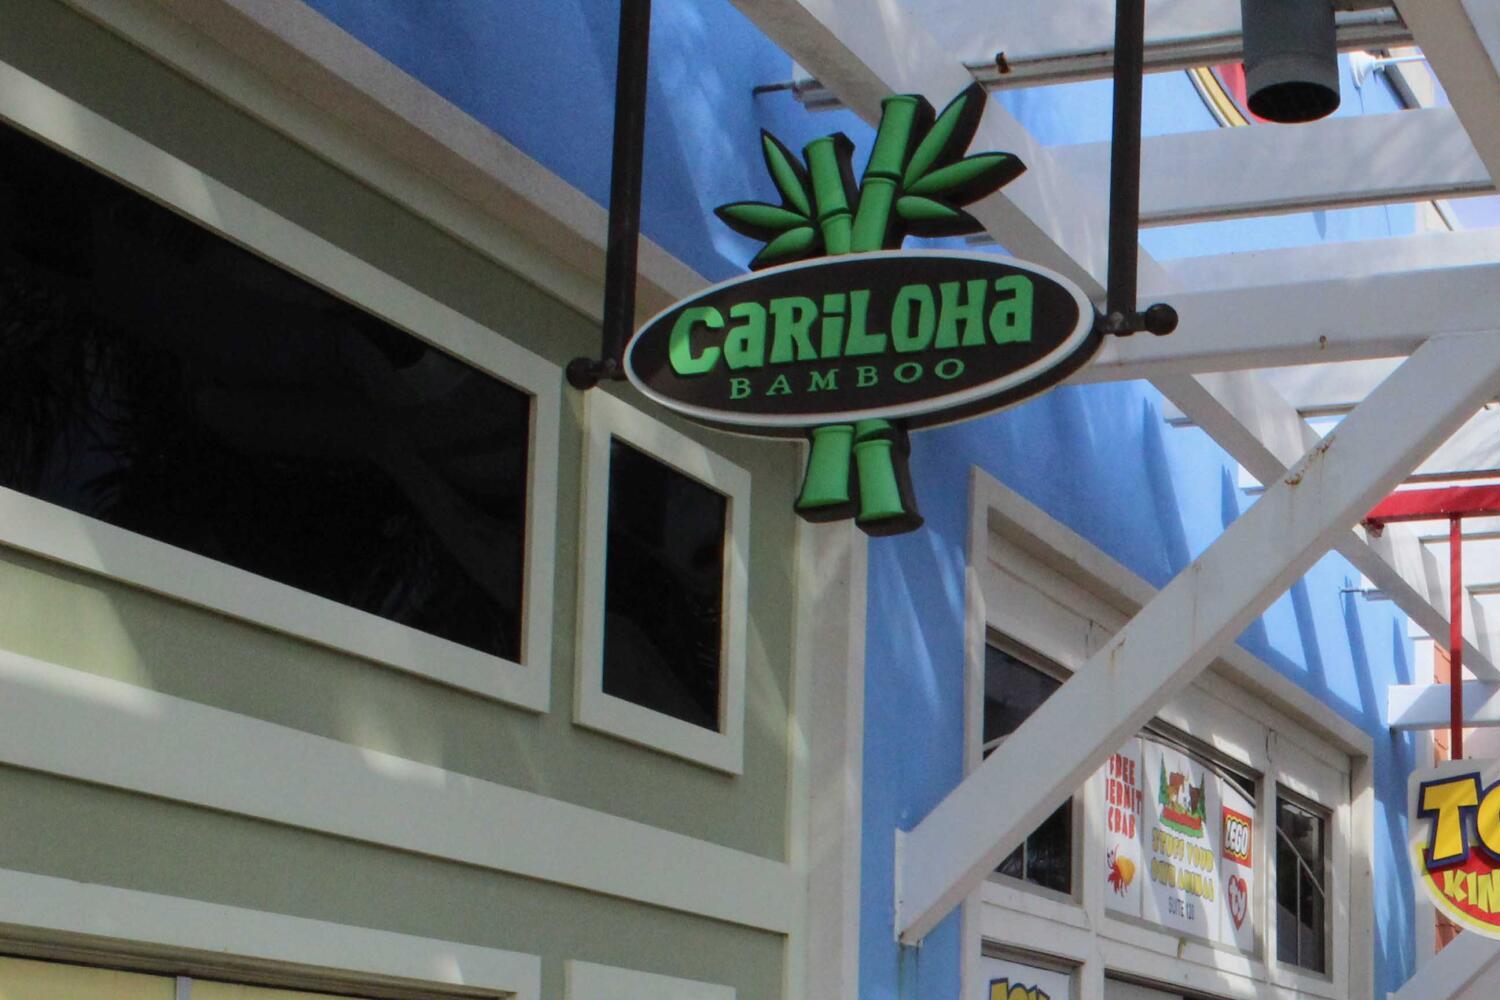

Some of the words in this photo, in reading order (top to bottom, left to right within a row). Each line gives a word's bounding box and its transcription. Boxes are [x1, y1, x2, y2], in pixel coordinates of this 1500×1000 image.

[729, 357, 966, 400] BAMBOO
[1109, 753, 1136, 785] FREE
[1107, 806, 1136, 839] CRAB
[1225, 815, 1250, 859] LEGO
